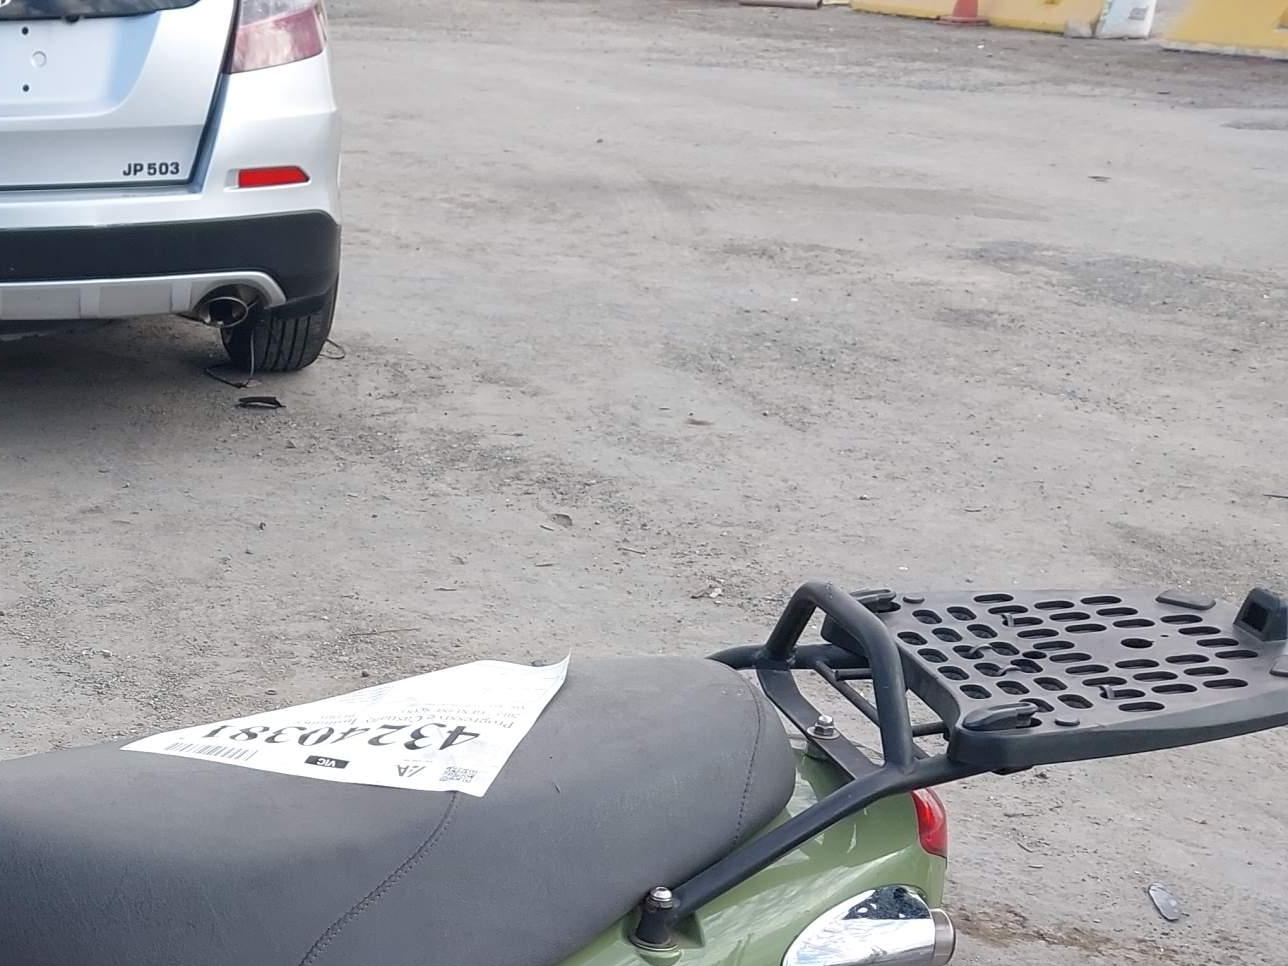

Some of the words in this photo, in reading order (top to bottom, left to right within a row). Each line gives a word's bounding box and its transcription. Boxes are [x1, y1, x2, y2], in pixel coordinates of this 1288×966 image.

[122, 163, 143, 177] JP
[146, 161, 181, 176] 503
[202, 723, 481, 751] 43240381
[316, 757, 337, 768] VIC
